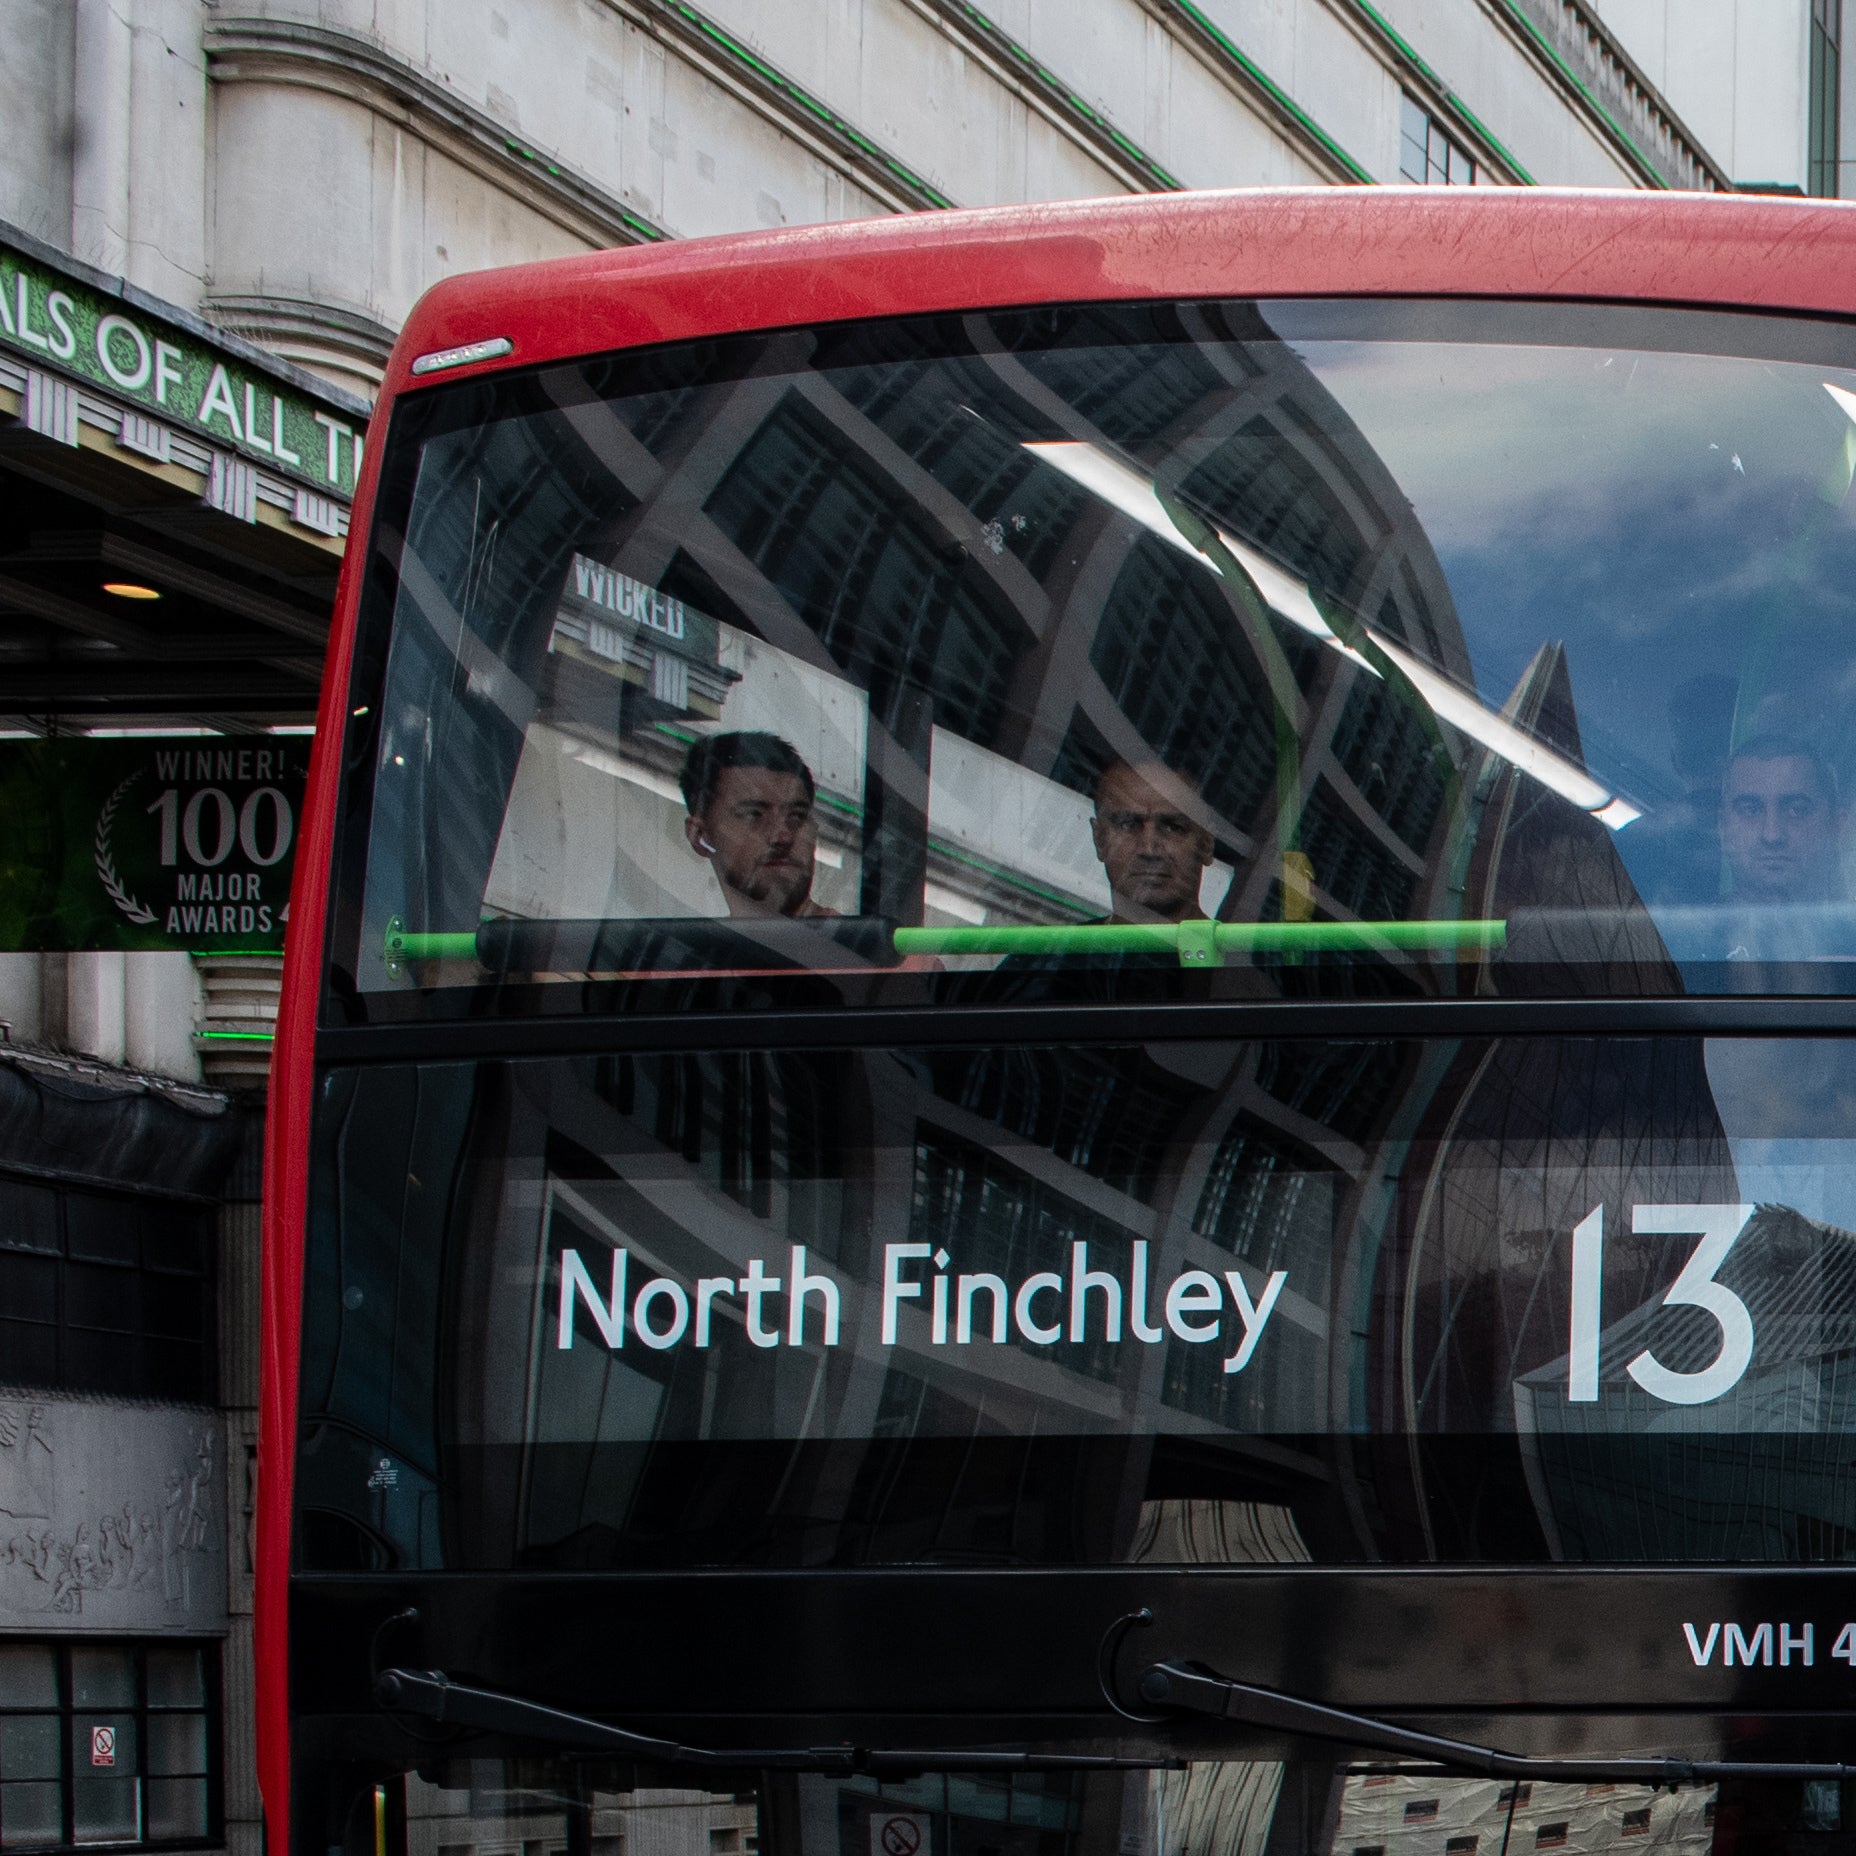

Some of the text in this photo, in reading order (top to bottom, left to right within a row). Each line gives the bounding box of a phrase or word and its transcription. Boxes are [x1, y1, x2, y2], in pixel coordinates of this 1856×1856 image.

[96, 313, 183, 404] OF
[199, 369, 301, 467] ALL
[156, 750, 285, 781] WINNER!
[146, 786, 293, 867] 100
[178, 874, 262, 901] MAJOR
[166, 906, 273, 934] AWARDS
[557, 1240, 1289, 1373] North Finchley
[1568, 1202, 1755, 1405] 13
[1682, 1622, 1814, 1667] VMH
